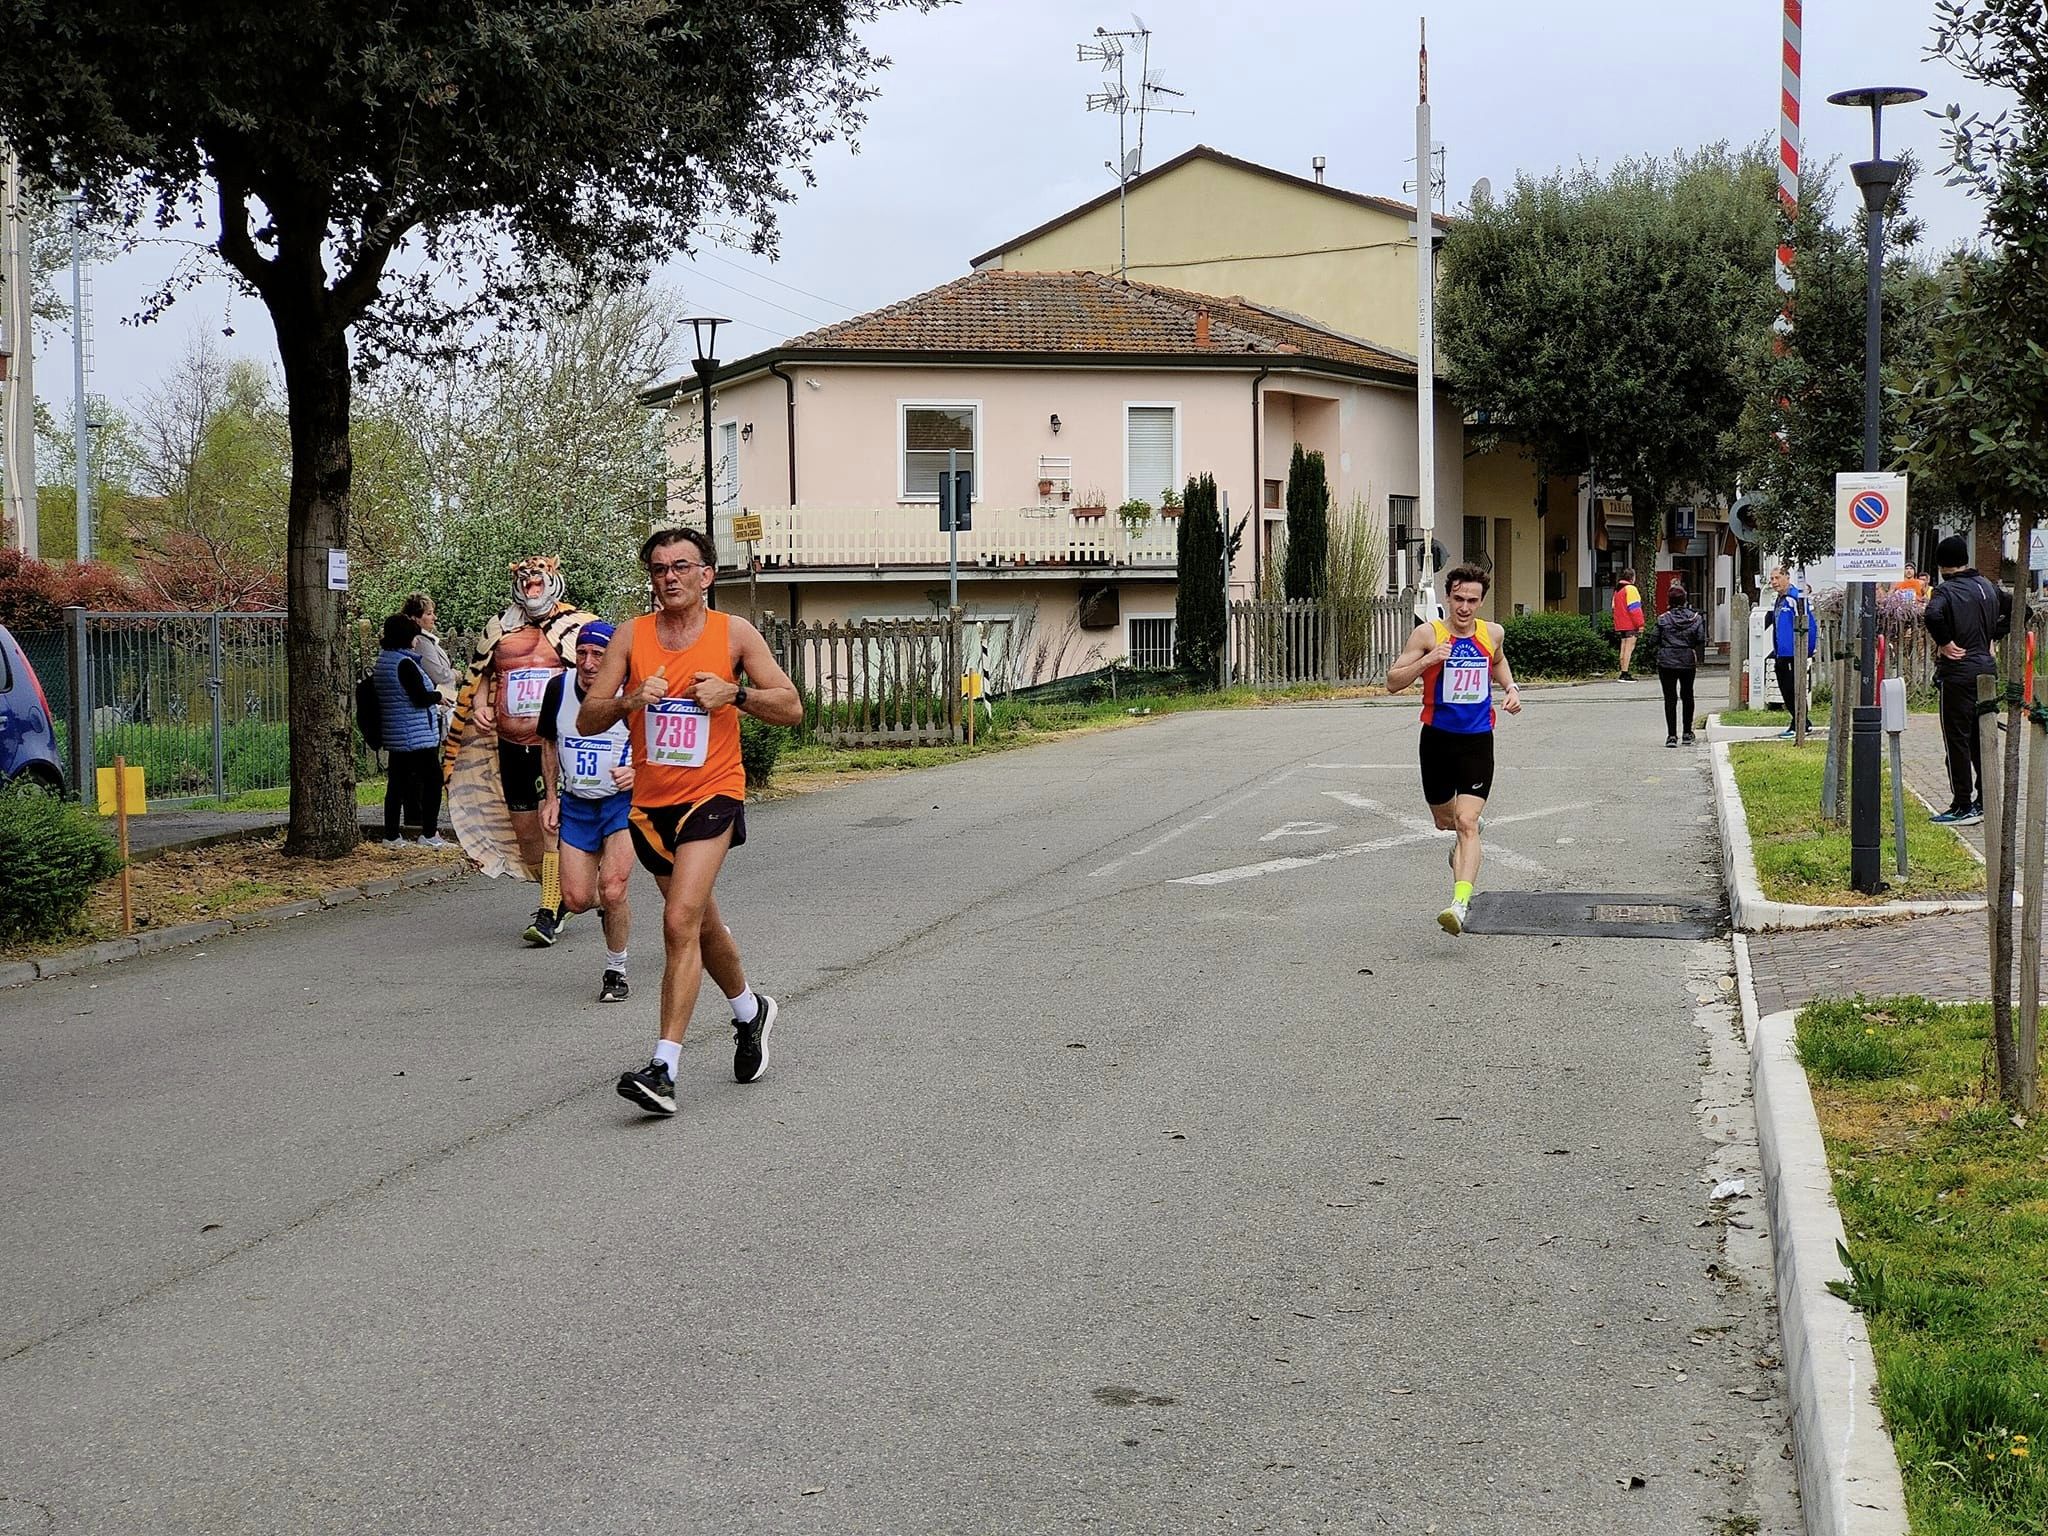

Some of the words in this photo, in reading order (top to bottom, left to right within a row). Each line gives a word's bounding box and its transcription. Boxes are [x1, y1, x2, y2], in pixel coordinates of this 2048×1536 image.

[1610, 502, 1633, 514] TABACC
[517, 680, 543, 702] 247
[1454, 669, 1481, 691] 274
[656, 715, 696, 748] 238
[576, 751, 597, 777] 53
